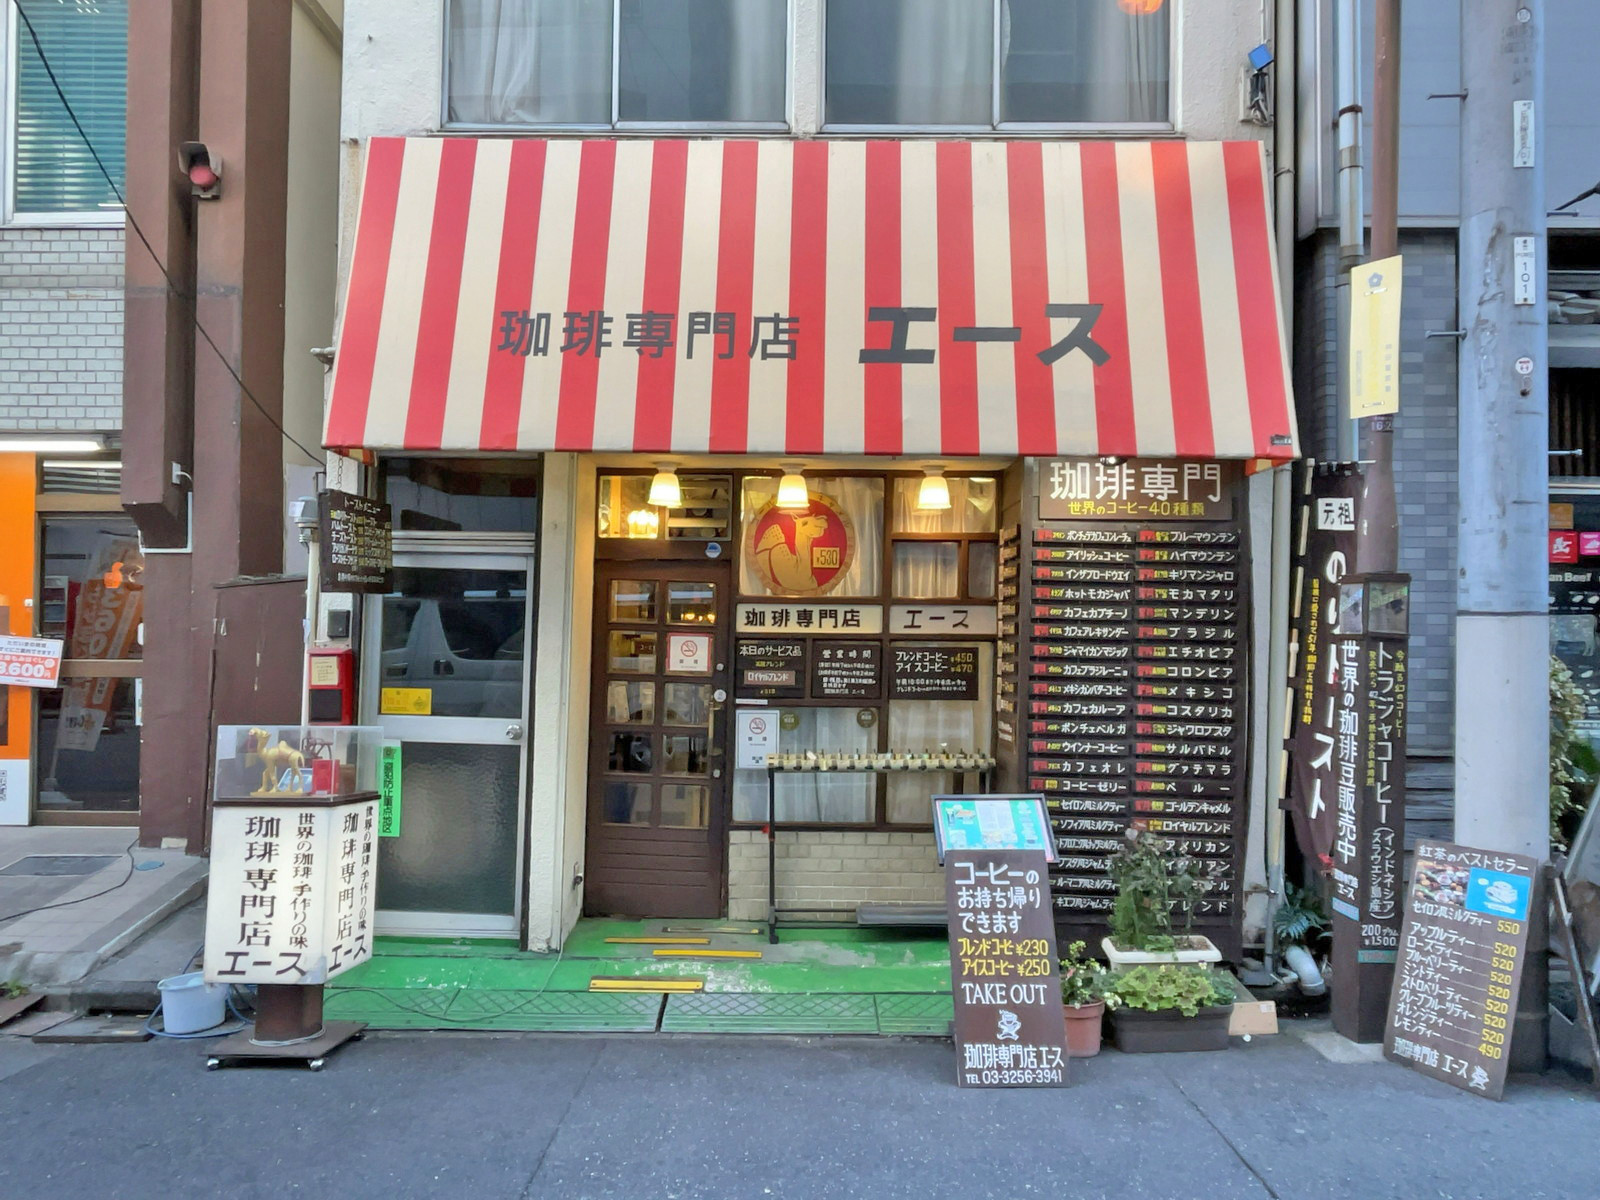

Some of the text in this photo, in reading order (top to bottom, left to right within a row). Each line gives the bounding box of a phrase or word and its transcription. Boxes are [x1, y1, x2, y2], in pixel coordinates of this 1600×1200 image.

[498, 304, 1110, 367] 珈琲専門店 エース
[1050, 462, 1221, 503] 珈琲専門
[1068, 501, 1205, 516] 世界のコーヒー40種類
[1324, 502, 1354, 525] 元祖
[1171, 531, 1235, 542] ブルーマウンテン
[1066, 550, 1129, 561] アイリッシュコーヒー
[1170, 551, 1235, 561] ハイマウンテン
[1169, 569, 1233, 581] キリマンジャロ
[1169, 589, 1233, 600] モカマタリ
[744, 609, 969, 629] 珈琲専門店 エース
[1064, 607, 1127, 619] カフェカプチーノ
[1170, 608, 1234, 620] マンデリン
[1169, 627, 1234, 639] ブラジル
[740, 645, 802, 656] 本日のサービス品
[896, 652, 948, 662] ブレンドコーヒー
[1169, 647, 1233, 658] エチオピア
[896, 663, 948, 673] アイスコーヒー
[1168, 666, 1233, 677] コロンビア
[1168, 686, 1232, 698] メキシコ
[1063, 704, 1126, 715] カフェカルーア
[1168, 706, 1232, 718] コスタリカ
[1167, 724, 1231, 736] ジャワロブスタ
[1376, 641, 1395, 824] トラジャコーヒー
[1062, 742, 1125, 753] ウインナーコーヒー
[1166, 744, 1231, 755] サルバドル
[1336, 640, 1361, 864] 世界の珈琲豆販売中
[1062, 761, 1125, 773] カフェオレ
[1063, 780, 1126, 791] コーヒーゼリー
[1166, 802, 1230, 814] ゴールデンキャメル
[1163, 821, 1230, 833] ロイヤルブレンド
[1165, 840, 1230, 852] アメリカン
[1419, 845, 1529, 872] 紅茶のベストセラー
[336, 812, 359, 941] 珈琲専門店
[954, 862, 1039, 884] コーヒーの
[237, 816, 281, 947] 珈琲専門店
[958, 886, 1040, 909] お持ち帰り
[958, 911, 1022, 934] できます
[1412, 901, 1520, 935] セイロン風ミルクティー 550
[1410, 921, 1517, 957] アップルティー 520
[328, 934, 367, 973] エース
[958, 938, 1048, 956] ブレンドコーヒー ¥230
[1407, 936, 1462, 956] ローズティー
[1492, 957, 1514, 972] 520
[217, 952, 307, 976] エース
[962, 959, 1050, 976] アイスコーヒー ¥250
[1404, 960, 1510, 999] ミントティー 520
[1490, 972, 1512, 985] 520
[961, 983, 1047, 1005] TAKE OUT
[1401, 975, 1508, 1014] ストロベリーティー 520
[1397, 1003, 1504, 1045] オレンジティー 520
[1484, 1014, 1506, 1029] 520
[1394, 1016, 1502, 1059] レモンティー 490
[964, 1044, 1064, 1069] 珈琲専門店 エース
[1442, 1055, 1469, 1078] エース
[966, 1069, 1062, 1084] TEL 03-3256-3941
